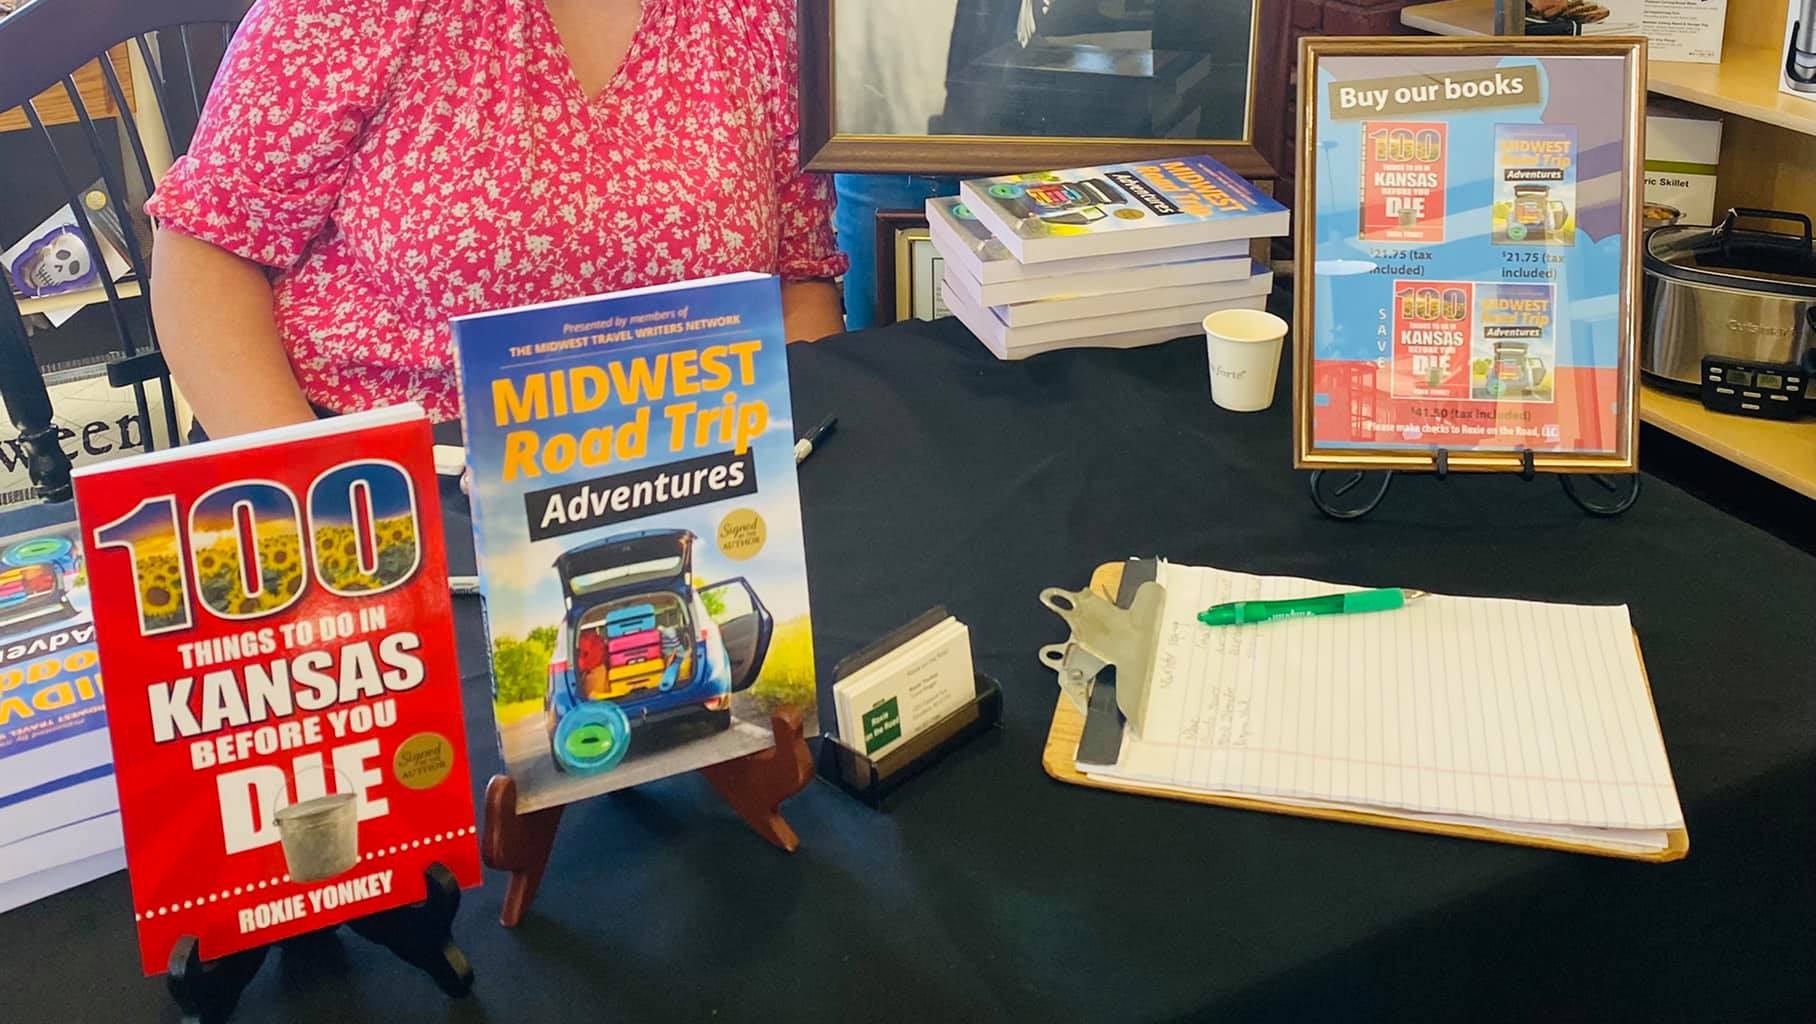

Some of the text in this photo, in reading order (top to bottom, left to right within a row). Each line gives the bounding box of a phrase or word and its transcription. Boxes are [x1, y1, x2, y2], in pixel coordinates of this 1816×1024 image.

[1339, 73, 1524, 112] Buy our books
[1368, 128, 1442, 162] 100
[1160, 161, 1249, 212] MIDWEST
[1374, 172, 1438, 188] KANSAS
[1506, 170, 1562, 180] Adventures
[1643, 178, 1689, 189] ric Skillet
[1385, 197, 1425, 218] DIE
[1409, 249, 1432, 261] (tax
[1502, 251, 1539, 263] $21.75
[1502, 267, 1557, 280] included)
[563, 306, 689, 334] Presented by members of
[1395, 287, 1467, 321] 100
[508, 314, 741, 358] THE MIDWEST TRAVEL WRITERS NETWORK
[1401, 330, 1464, 346] KANSAS
[1487, 328, 1540, 337] Adventures
[1412, 354, 1452, 376] DIE
[491, 340, 762, 427] MIDWEST
[502, 392, 769, 481] Road Trip
[1422, 424, 1449, 434] checks
[1451, 425, 1460, 434] to
[1461, 425, 1485, 435] Roxie
[539, 460, 745, 529] Adventures
[94, 458, 422, 637] 100
[0, 626, 95, 665] Adve
[177, 605, 387, 670] THINGS TO DO IN
[146, 630, 426, 745] KANSAS
[190, 698, 398, 771] BEFORE YOU
[216, 738, 390, 856] DIE
[238, 869, 394, 934] ROXIE YONKEY
